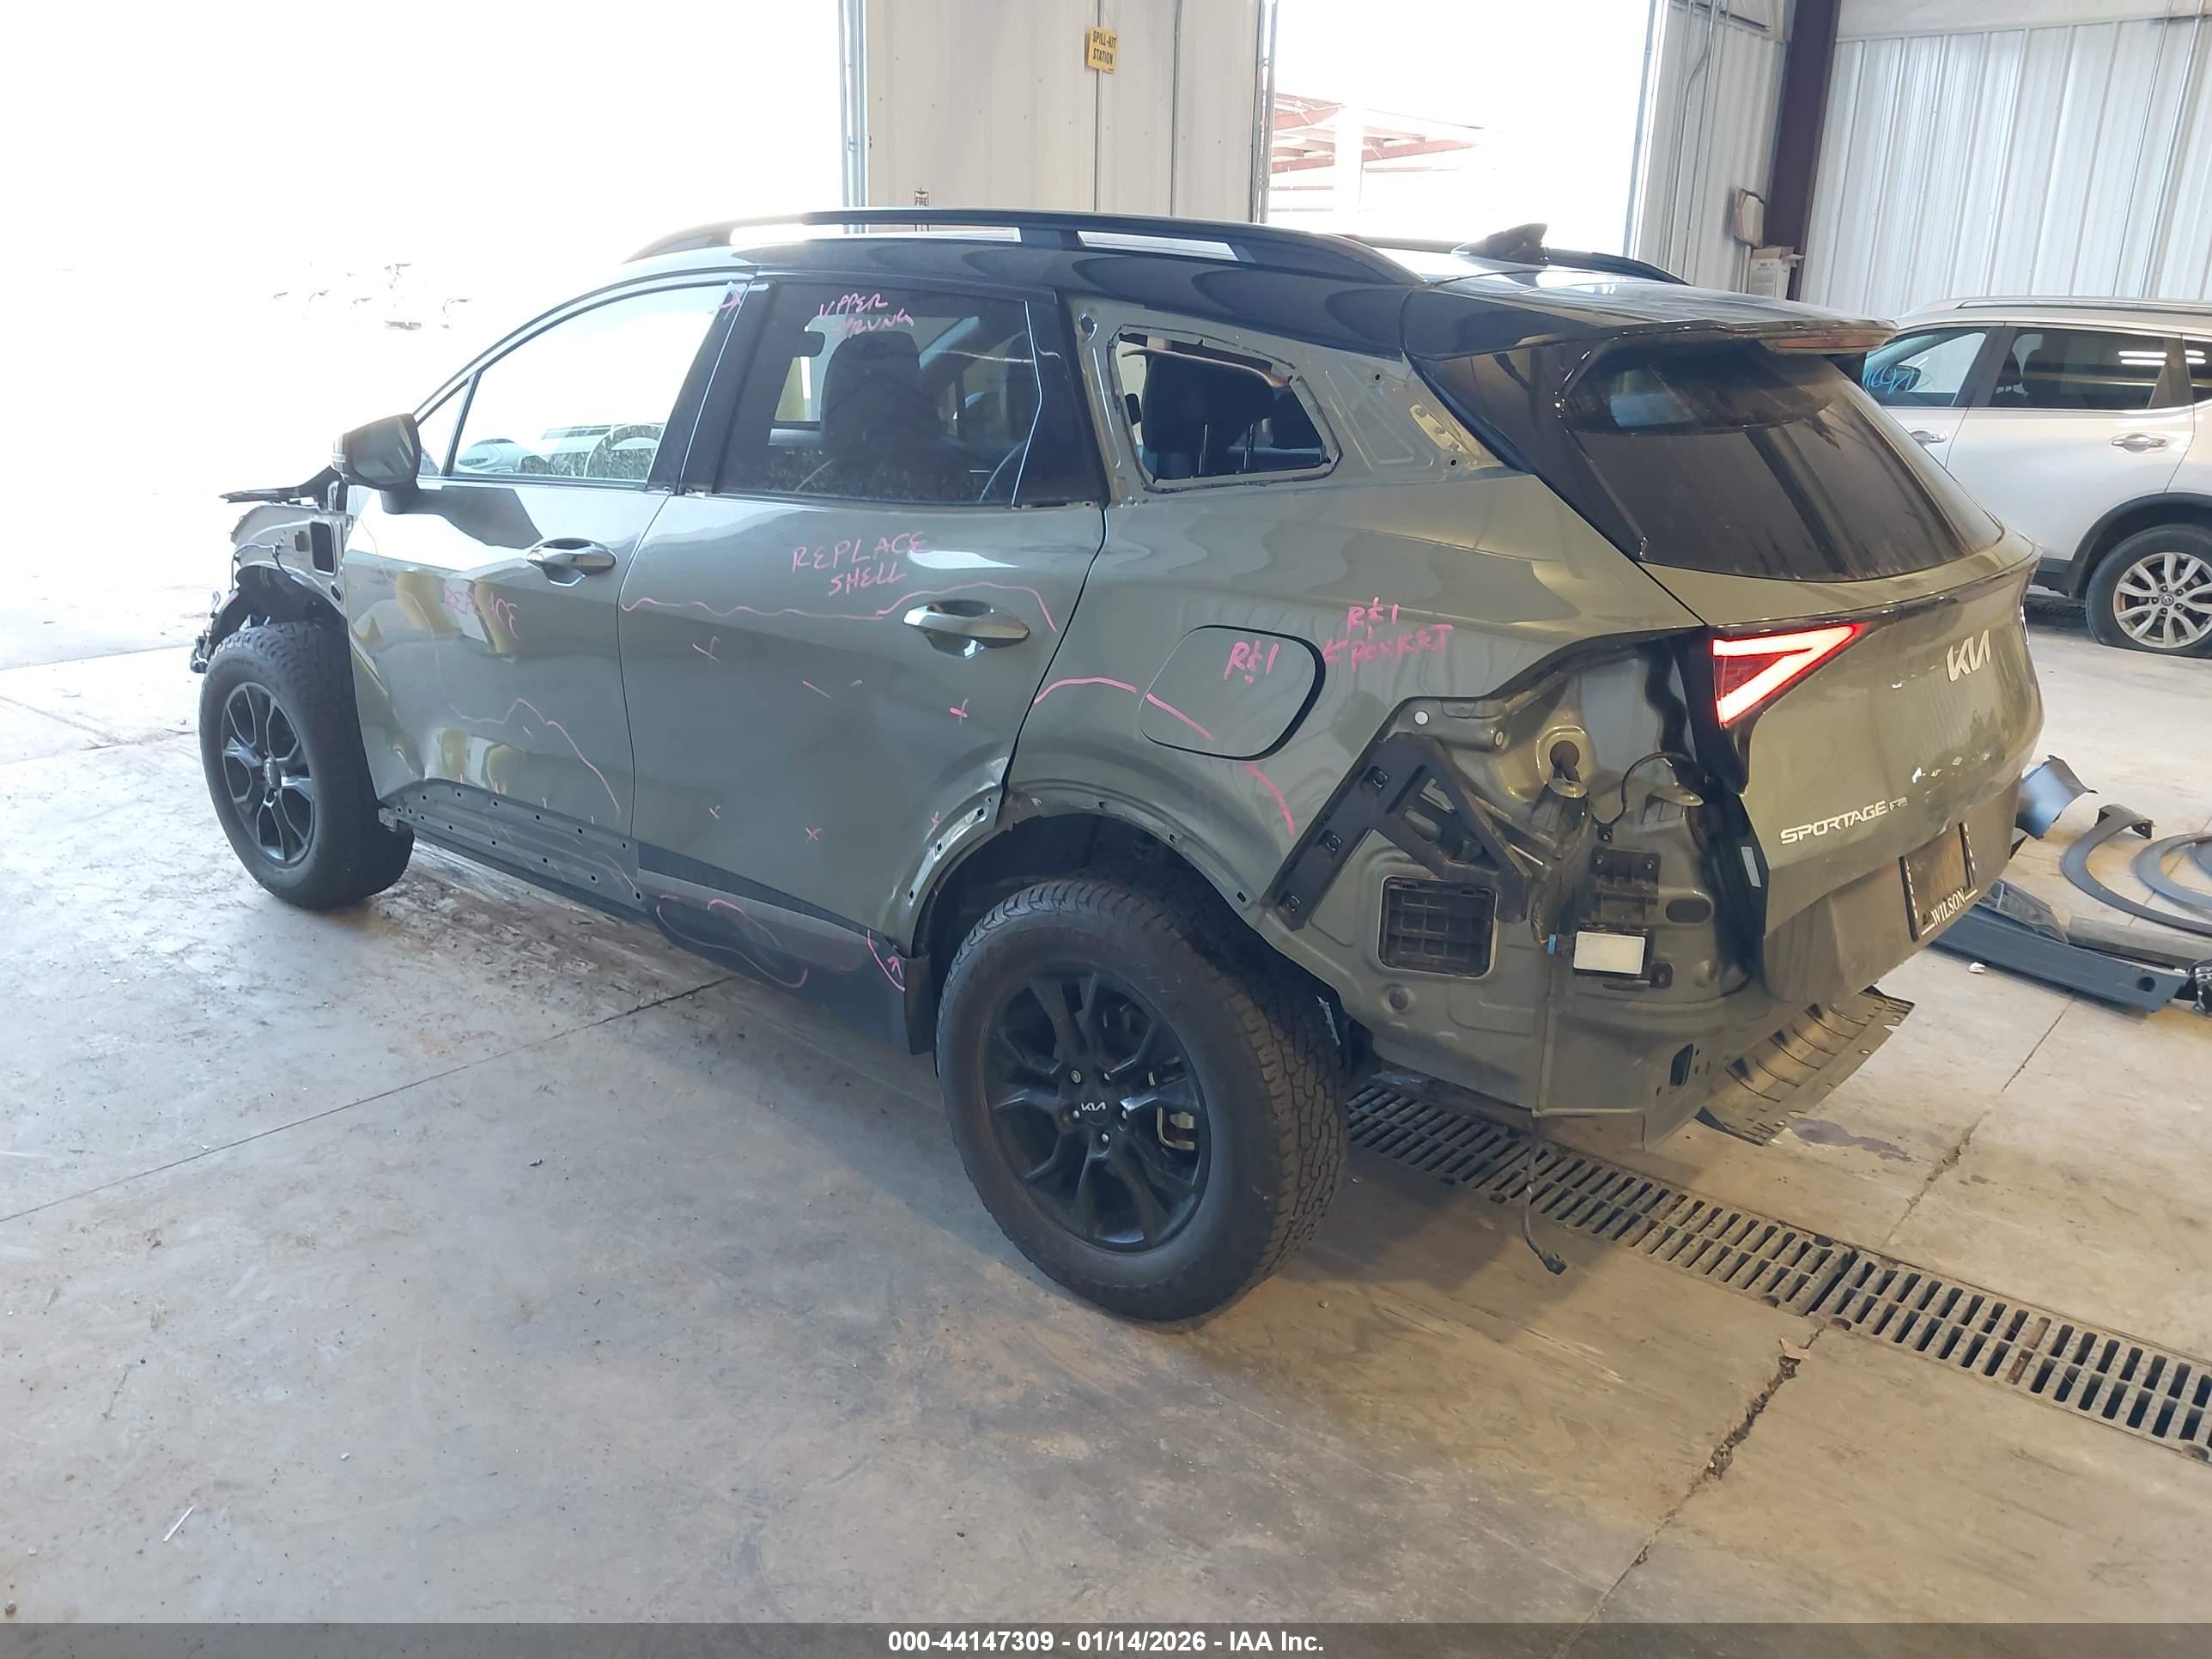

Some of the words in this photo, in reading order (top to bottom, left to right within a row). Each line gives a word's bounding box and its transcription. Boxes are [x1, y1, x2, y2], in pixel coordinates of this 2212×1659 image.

[1092, 30, 1116, 49] SPILL-KIT
[1092, 47, 1114, 66] STATION
[792, 531, 934, 573] REPLACE
[828, 562, 908, 597] SHELL
[1946, 629, 1991, 682] KIA
[1780, 799, 1888, 845] SPORTAGE
[1930, 888, 1966, 927] WILSON
[1081, 1101, 1107, 1112] KIA
